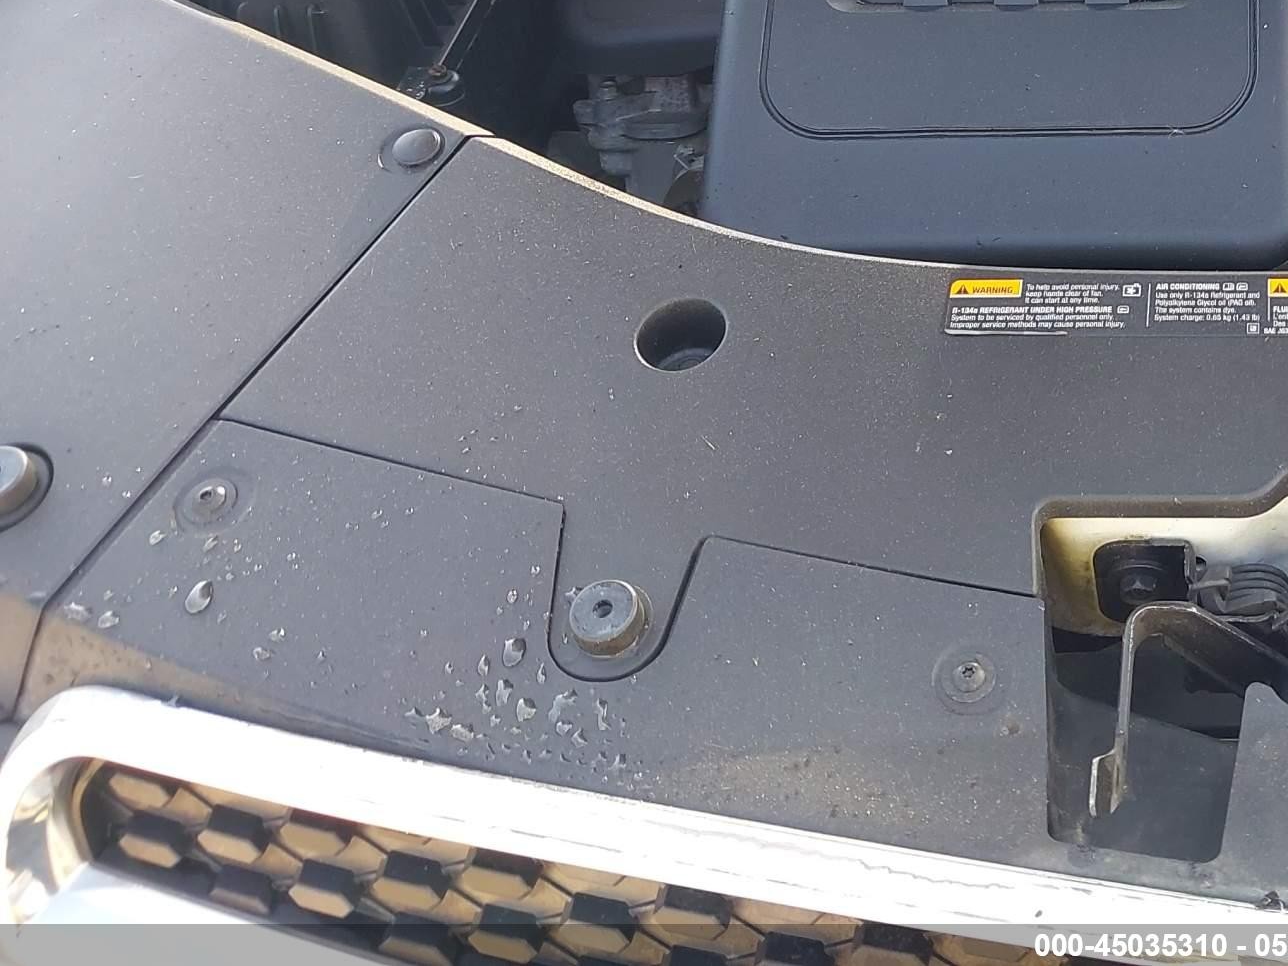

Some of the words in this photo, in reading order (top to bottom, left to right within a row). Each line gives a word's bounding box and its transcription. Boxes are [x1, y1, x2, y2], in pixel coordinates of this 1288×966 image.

[971, 286, 1013, 294] WARNING
[1026, 283, 1035, 292] To
[1036, 283, 1050, 292] help
[1051, 283, 1069, 292] avoid
[1071, 283, 1099, 292] personal
[1155, 283, 1168, 291] AIR
[1169, 283, 1220, 291] CONDITIONING
[1155, 292, 1168, 300] Use
[1168, 292, 1183, 300] only
[1184, 292, 1209, 300] R-134a
[1246, 292, 1260, 300] and
[952, 306, 978, 314] R-134a
[979, 306, 1030, 314] REFRIGERANT
[1030, 306, 1055, 314] UNDER
[1056, 306, 1074, 314] HIGH
[1075, 306, 1113, 314] PRESSURE
[951, 314, 976, 322] System
[978, 314, 985, 322] to
[986, 314, 995, 322] be
[996, 314, 1025, 322] serviced
[1025, 314, 1034, 322] by
[1035, 314, 1064, 322] qualified
[1065, 314, 1096, 322] personnel
[950, 321, 980, 329] Improper
[982, 321, 1006, 329] service
[1007, 321, 1036, 329] methods
[1038, 321, 1052, 329] may
[1054, 321, 1074, 329] cause
[1075, 321, 1104, 329] personal
[1105, 321, 1126, 329] injury.
